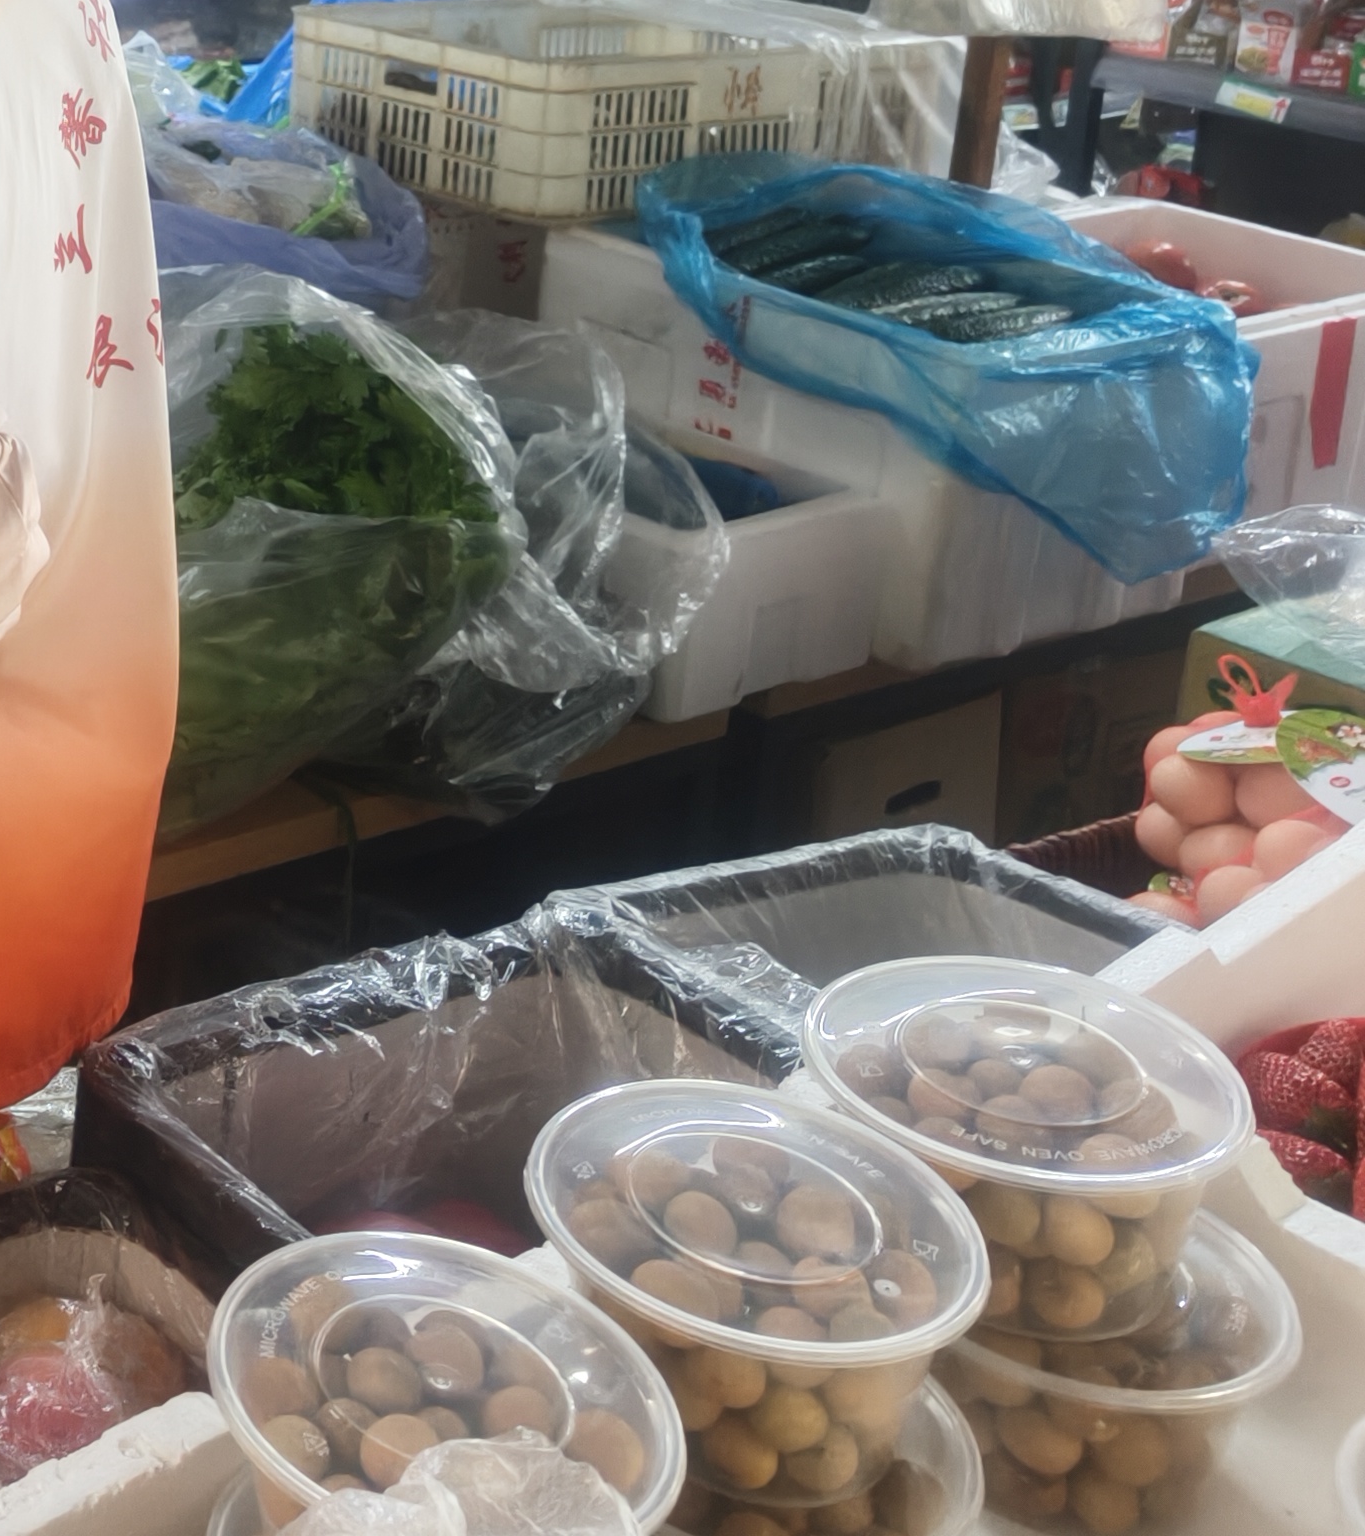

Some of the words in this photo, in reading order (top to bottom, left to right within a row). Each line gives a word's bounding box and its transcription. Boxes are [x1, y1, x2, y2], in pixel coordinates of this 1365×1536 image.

[950, 1124, 1009, 1152] SAFE
[1021, 1145, 1086, 1163] OVEN
[258, 1277, 323, 1360] MICROWAVE
